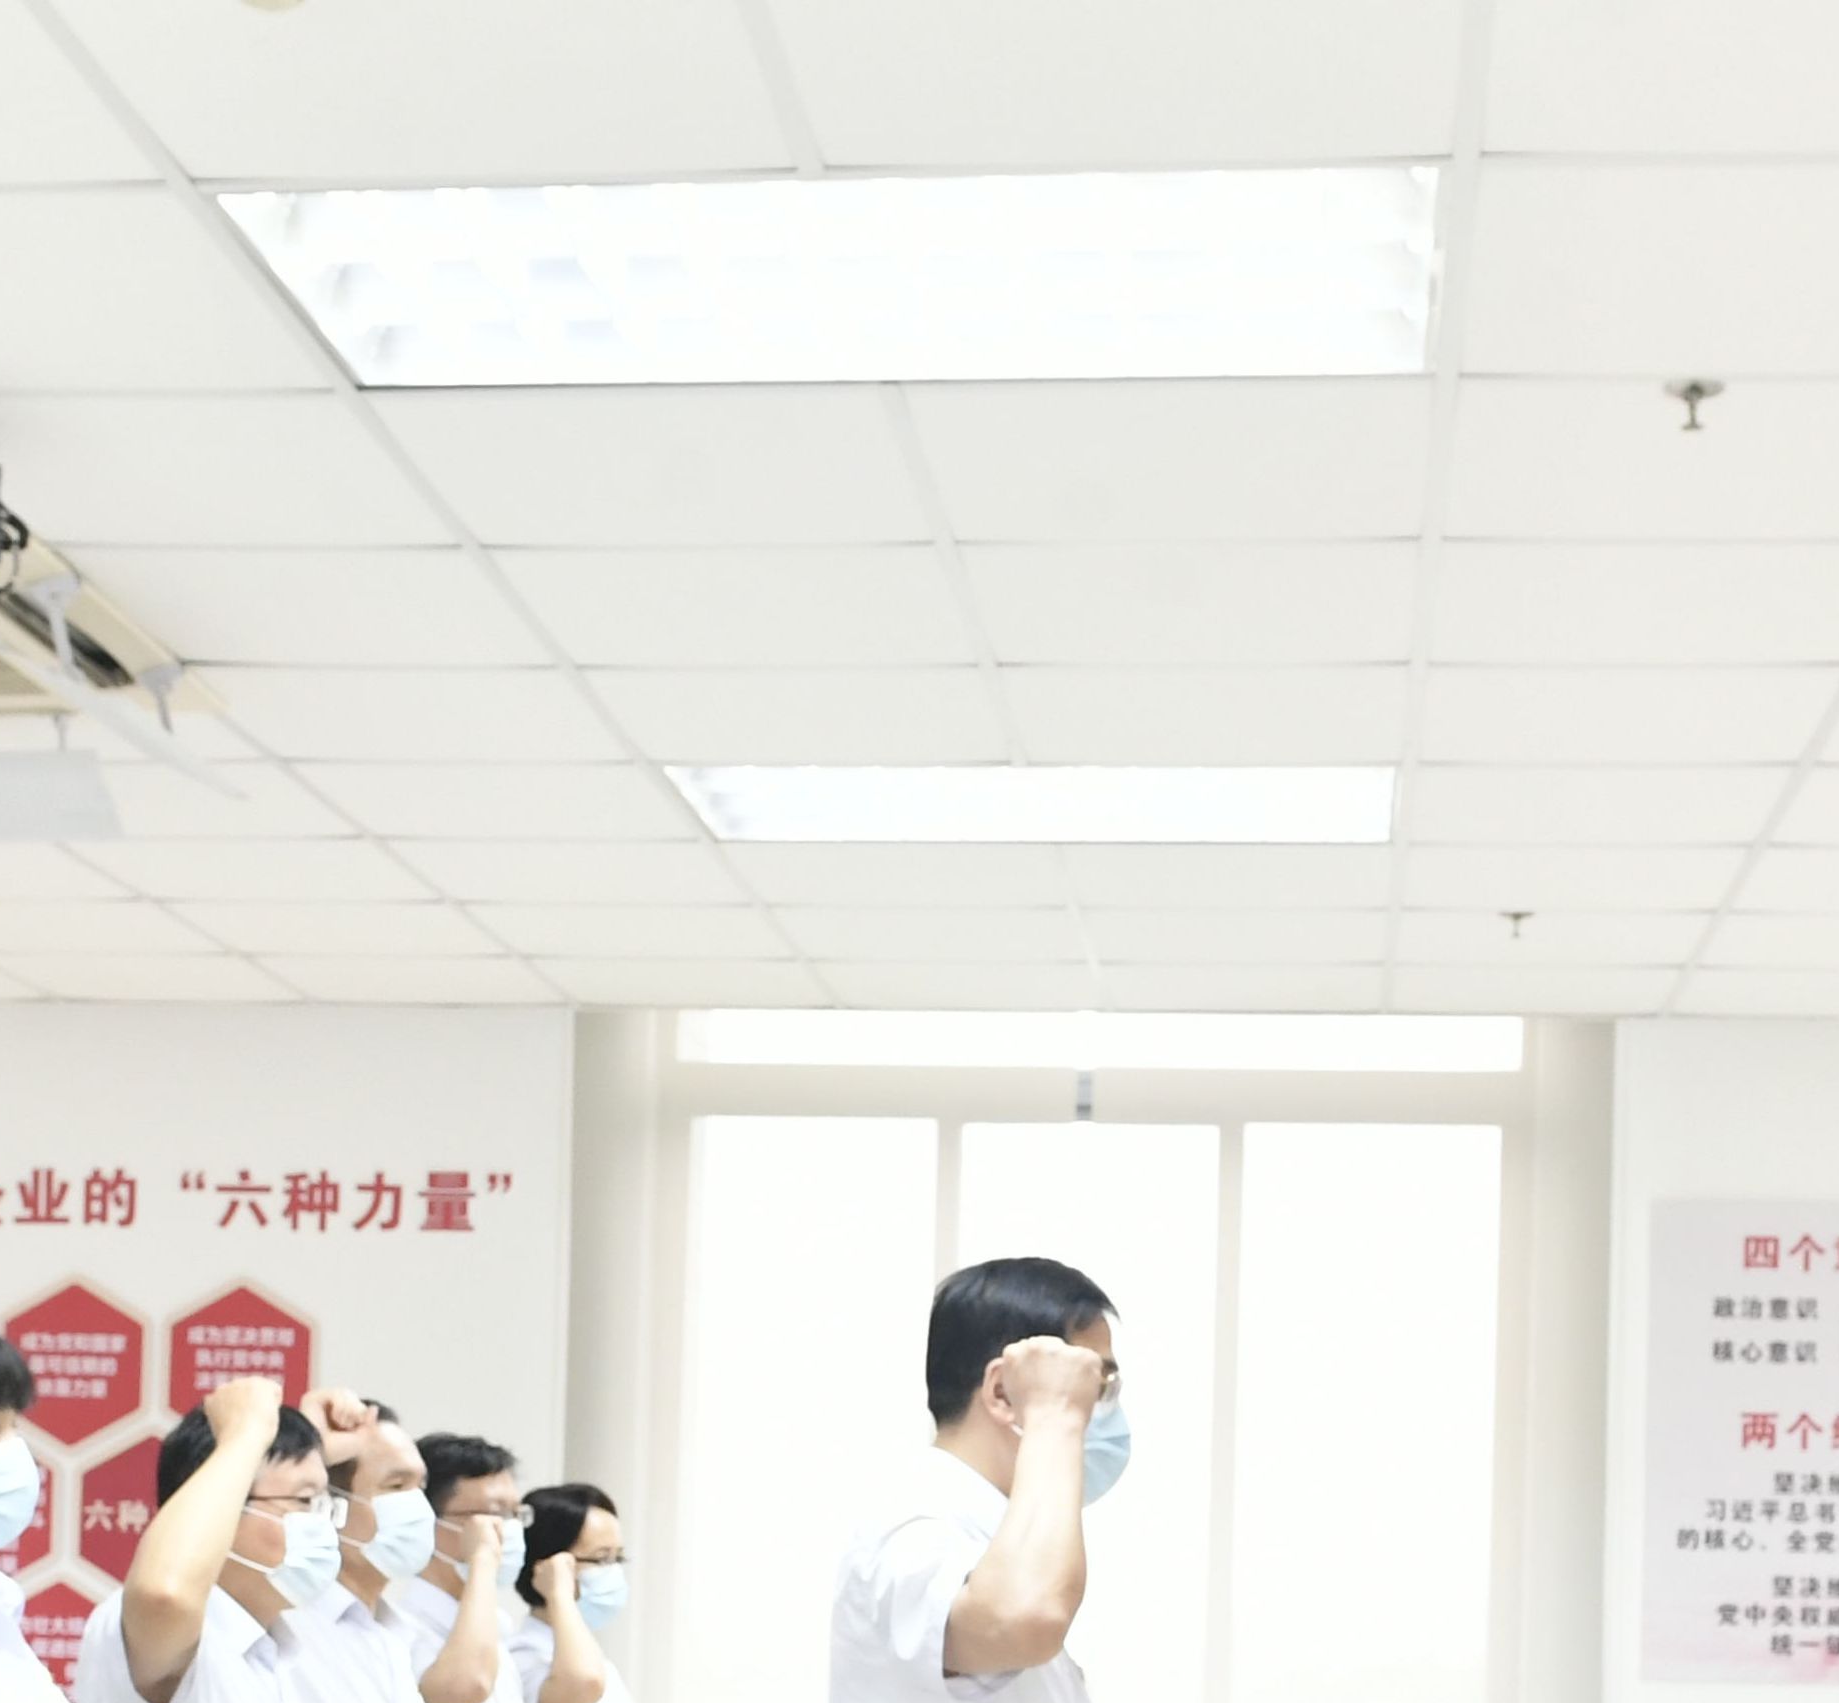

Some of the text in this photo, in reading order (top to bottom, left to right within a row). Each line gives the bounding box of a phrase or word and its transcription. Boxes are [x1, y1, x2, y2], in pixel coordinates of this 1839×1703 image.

[1713, 1296, 1819, 1320] 政治意识
[1712, 1340, 1817, 1364] 核心意识
